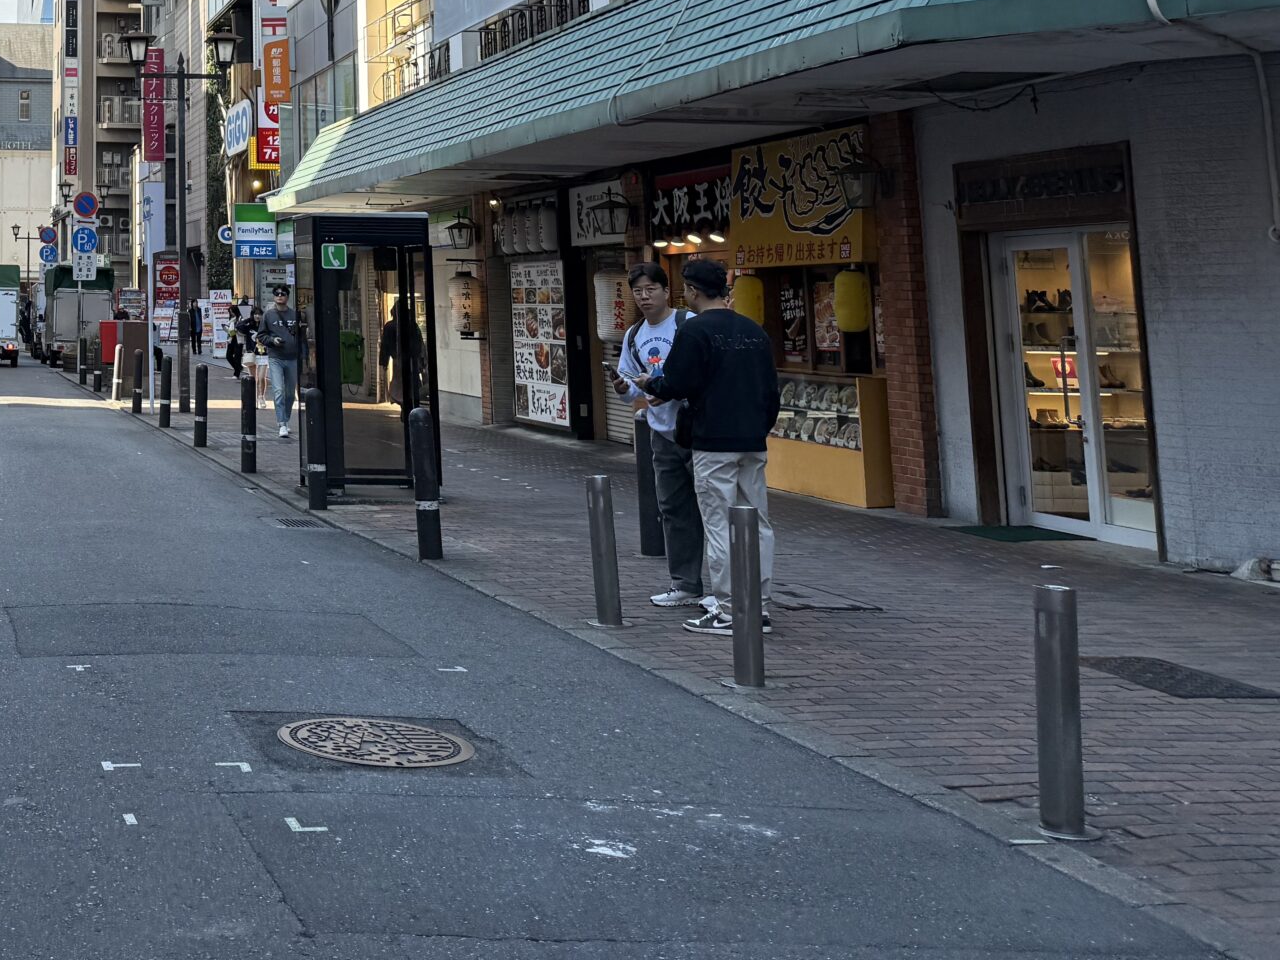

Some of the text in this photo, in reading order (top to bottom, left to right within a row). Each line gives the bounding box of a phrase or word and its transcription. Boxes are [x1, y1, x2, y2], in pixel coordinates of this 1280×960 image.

[1, 141, 33, 150] HOTEL
[237, 225, 274, 236] FamilyMart
[78, 234, 88, 250] P
[43, 248, 50, 260] P
[241, 245, 273, 256] 酒 たばこ
[747, 240, 839, 264] お持ち帰り出来ます
[213, 292, 228, 300] 24h
